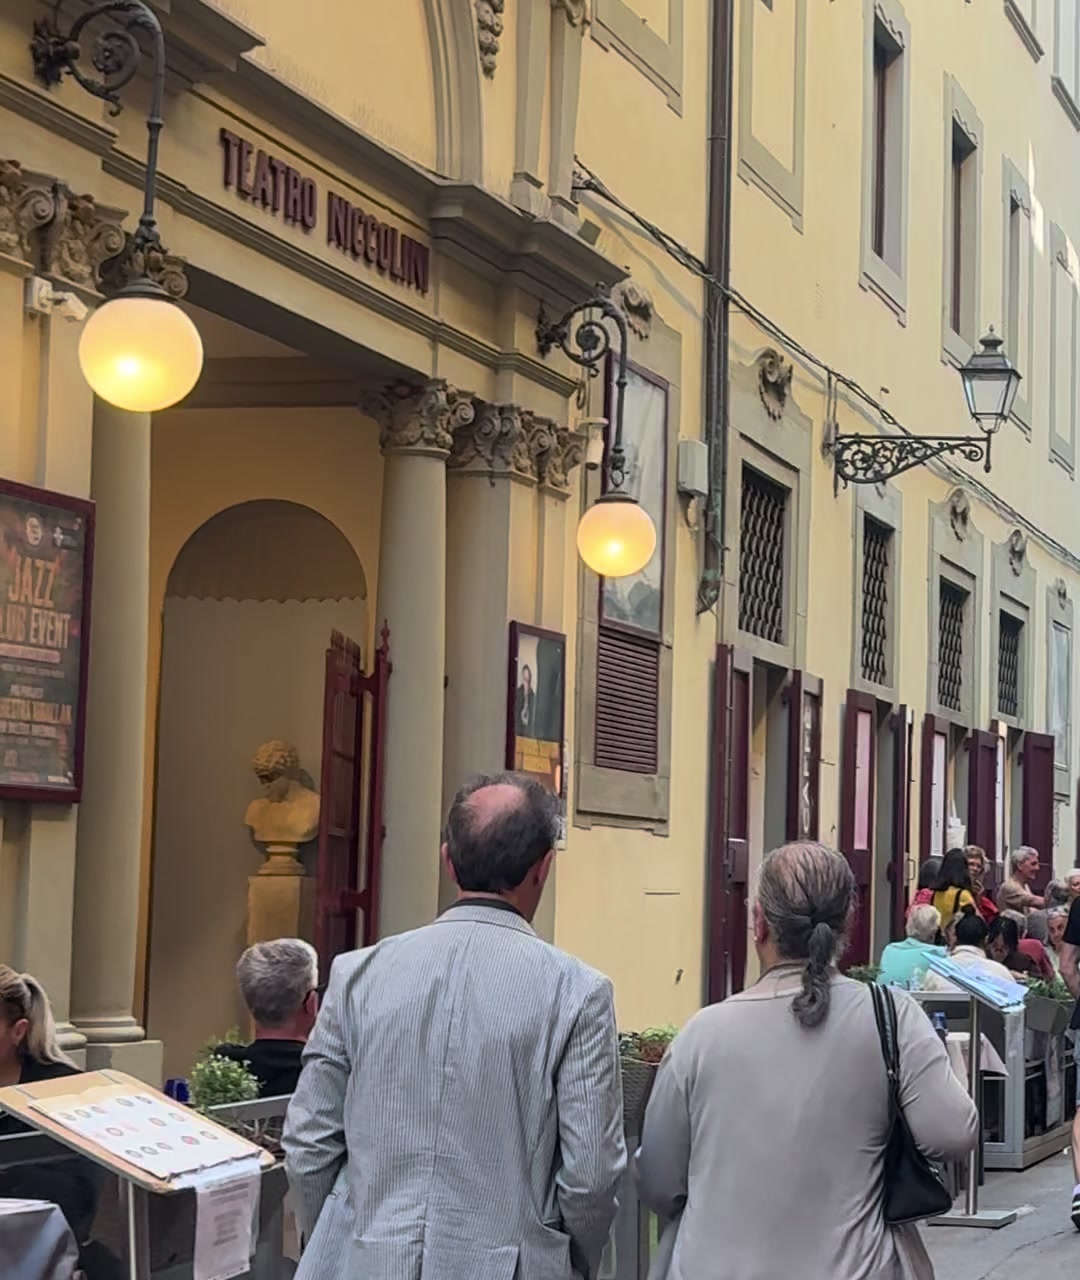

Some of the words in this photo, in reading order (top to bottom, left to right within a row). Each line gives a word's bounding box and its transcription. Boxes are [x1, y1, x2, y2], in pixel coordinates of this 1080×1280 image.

[220, 127, 317, 231] TEATRO
[8, 556, 56, 608] JAZZ
[0, 604, 26, 641] LUB
[30, 607, 72, 649] EVENT
